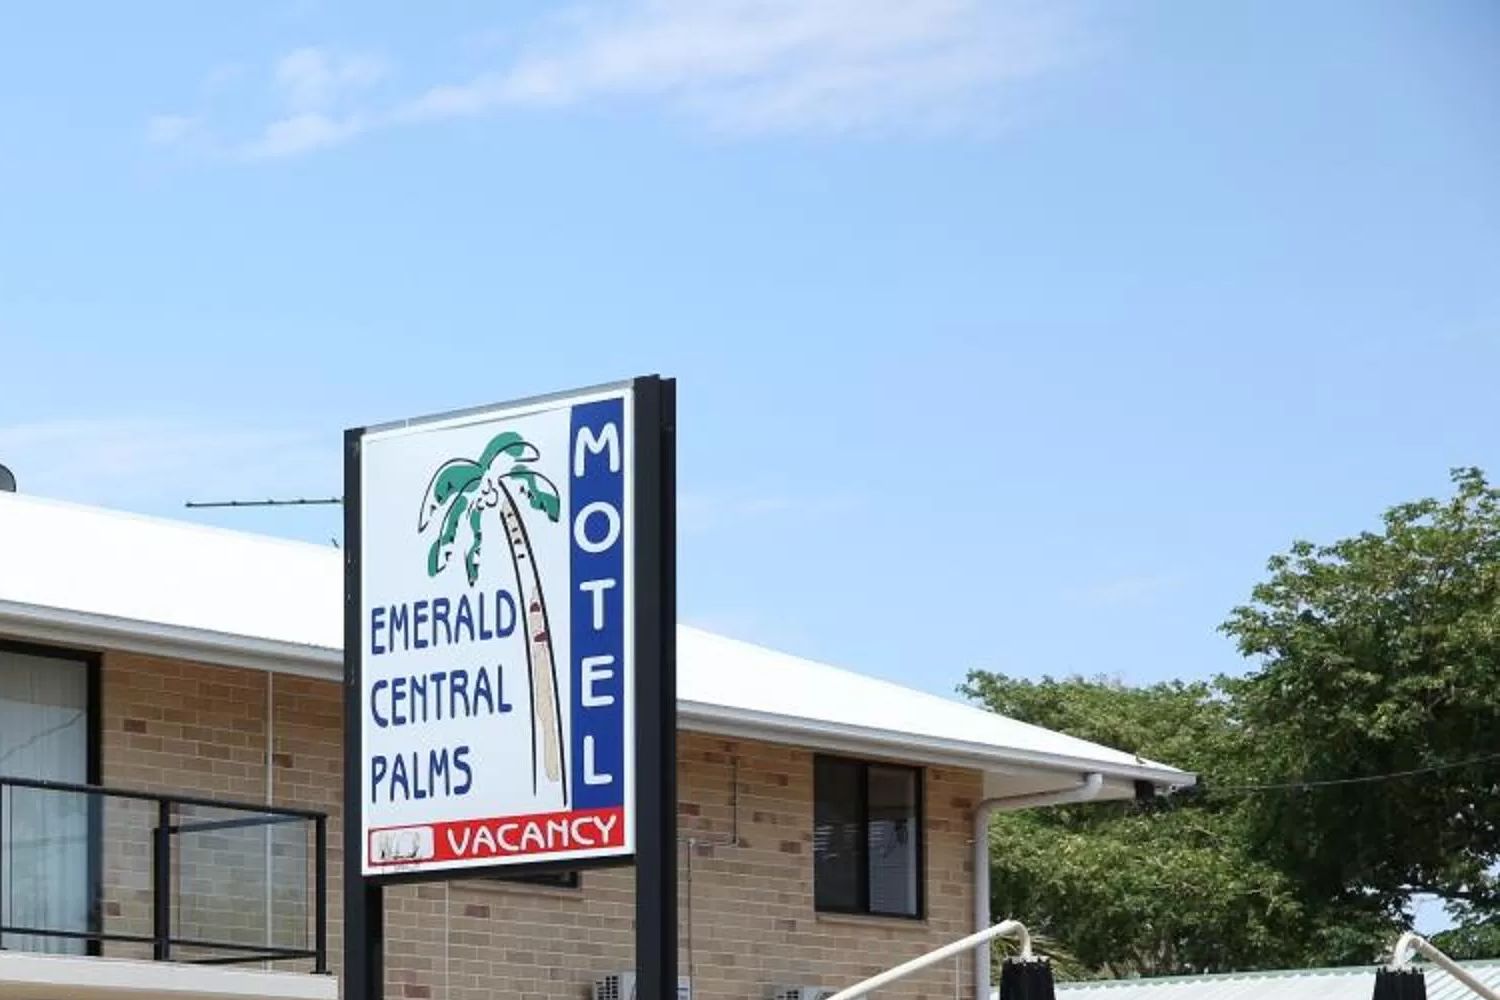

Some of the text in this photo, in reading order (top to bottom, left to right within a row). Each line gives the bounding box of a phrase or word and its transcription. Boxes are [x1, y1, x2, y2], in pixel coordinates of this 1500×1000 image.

[371, 589, 517, 655] EMERALD
[574, 422, 621, 786] MOTEL
[370, 664, 513, 728] CENTRAL
[371, 746, 473, 804] PALMS
[447, 815, 617, 856] VACANCY
